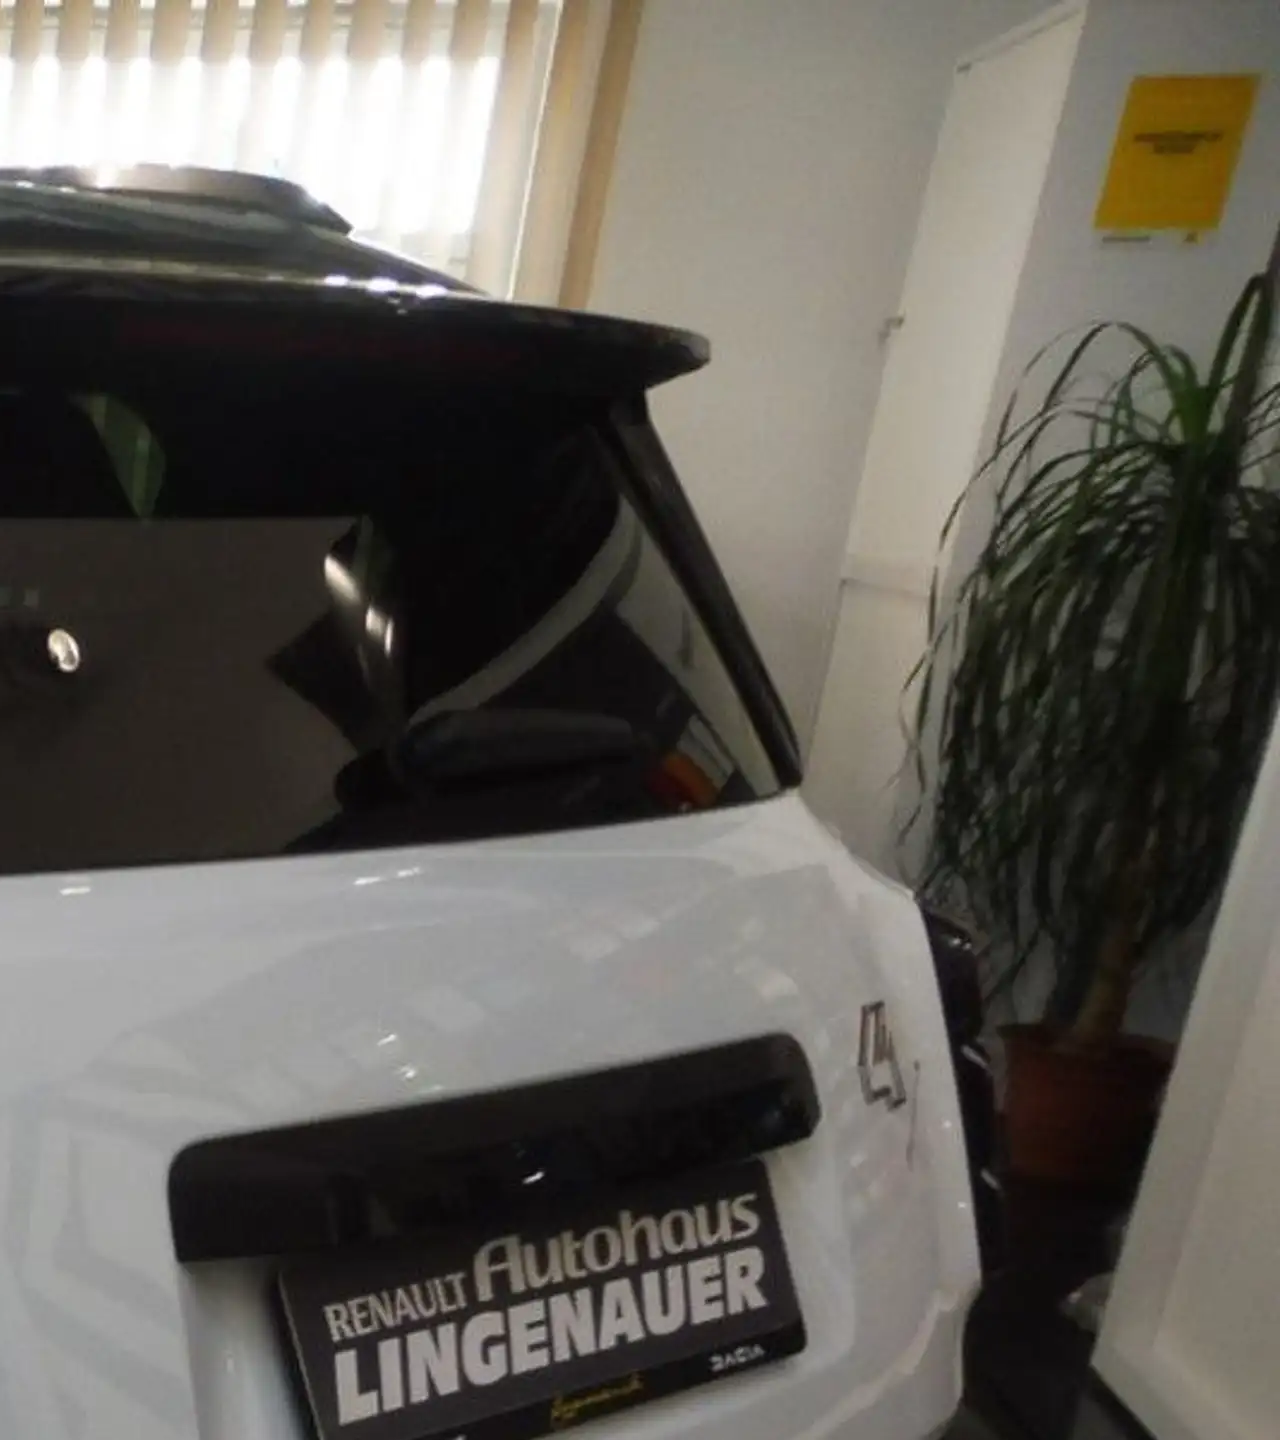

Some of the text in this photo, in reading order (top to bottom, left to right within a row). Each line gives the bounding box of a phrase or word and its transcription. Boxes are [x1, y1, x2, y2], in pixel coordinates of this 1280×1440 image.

[324, 1192, 761, 1342] RENAULT Autohaus
[334, 1246, 769, 1427] LINGENAUER
